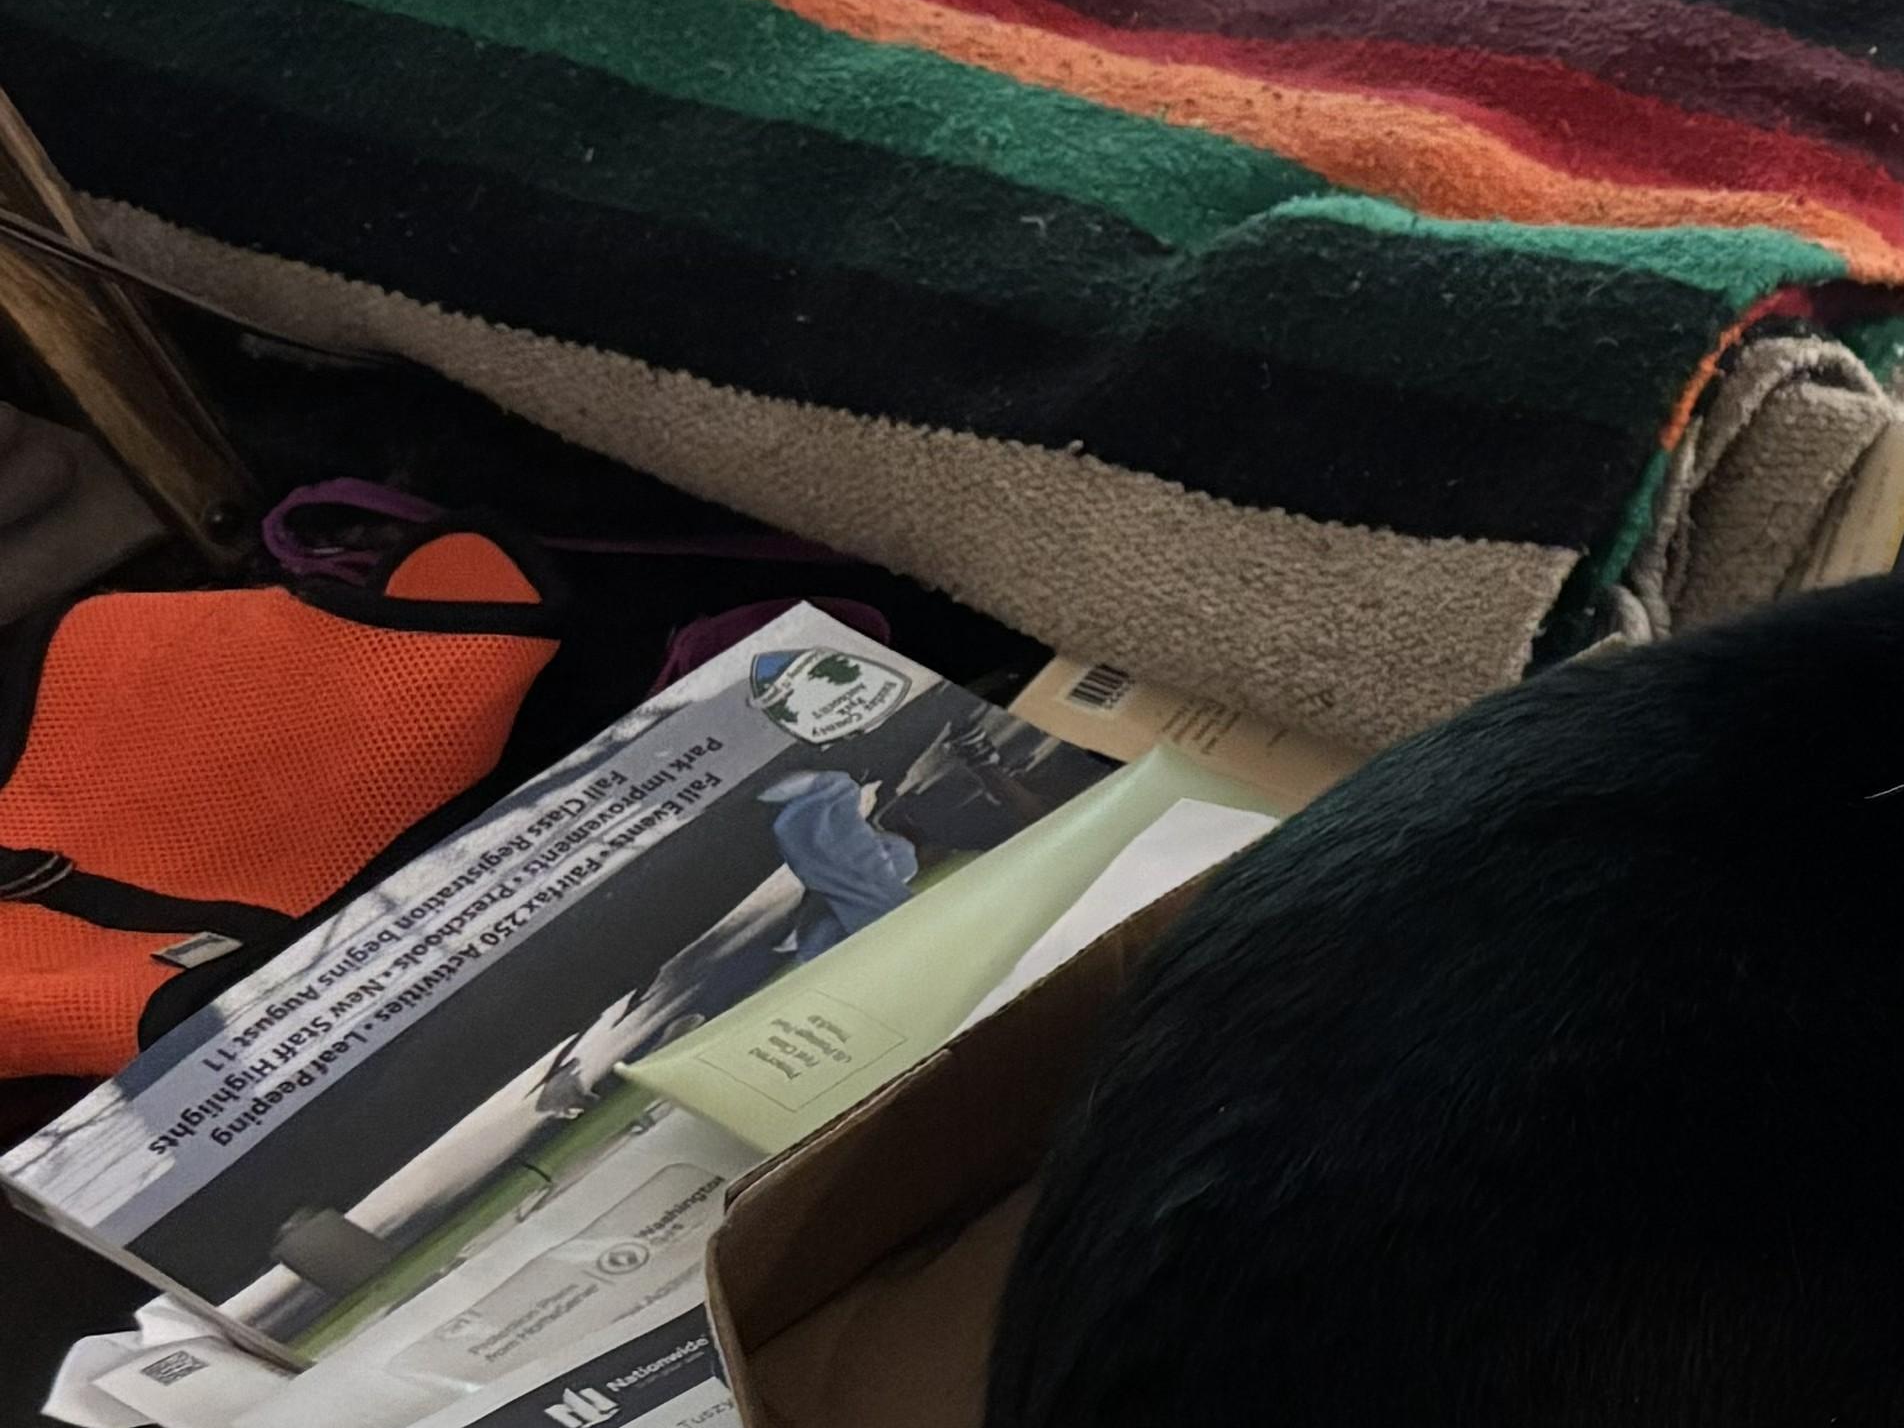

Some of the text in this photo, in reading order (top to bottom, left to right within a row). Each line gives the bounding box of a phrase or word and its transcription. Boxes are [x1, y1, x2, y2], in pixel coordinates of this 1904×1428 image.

[150, 737, 723, 1154] Park Improvements Preschools New Staff Highlights
[202, 771, 628, 1071] Fall Class Registration begins August 11
[211, 772, 721, 1146] Fall Events Fairfax 250 Activities Leaf Peeping
[605, 1336, 709, 1392] Nationwide
